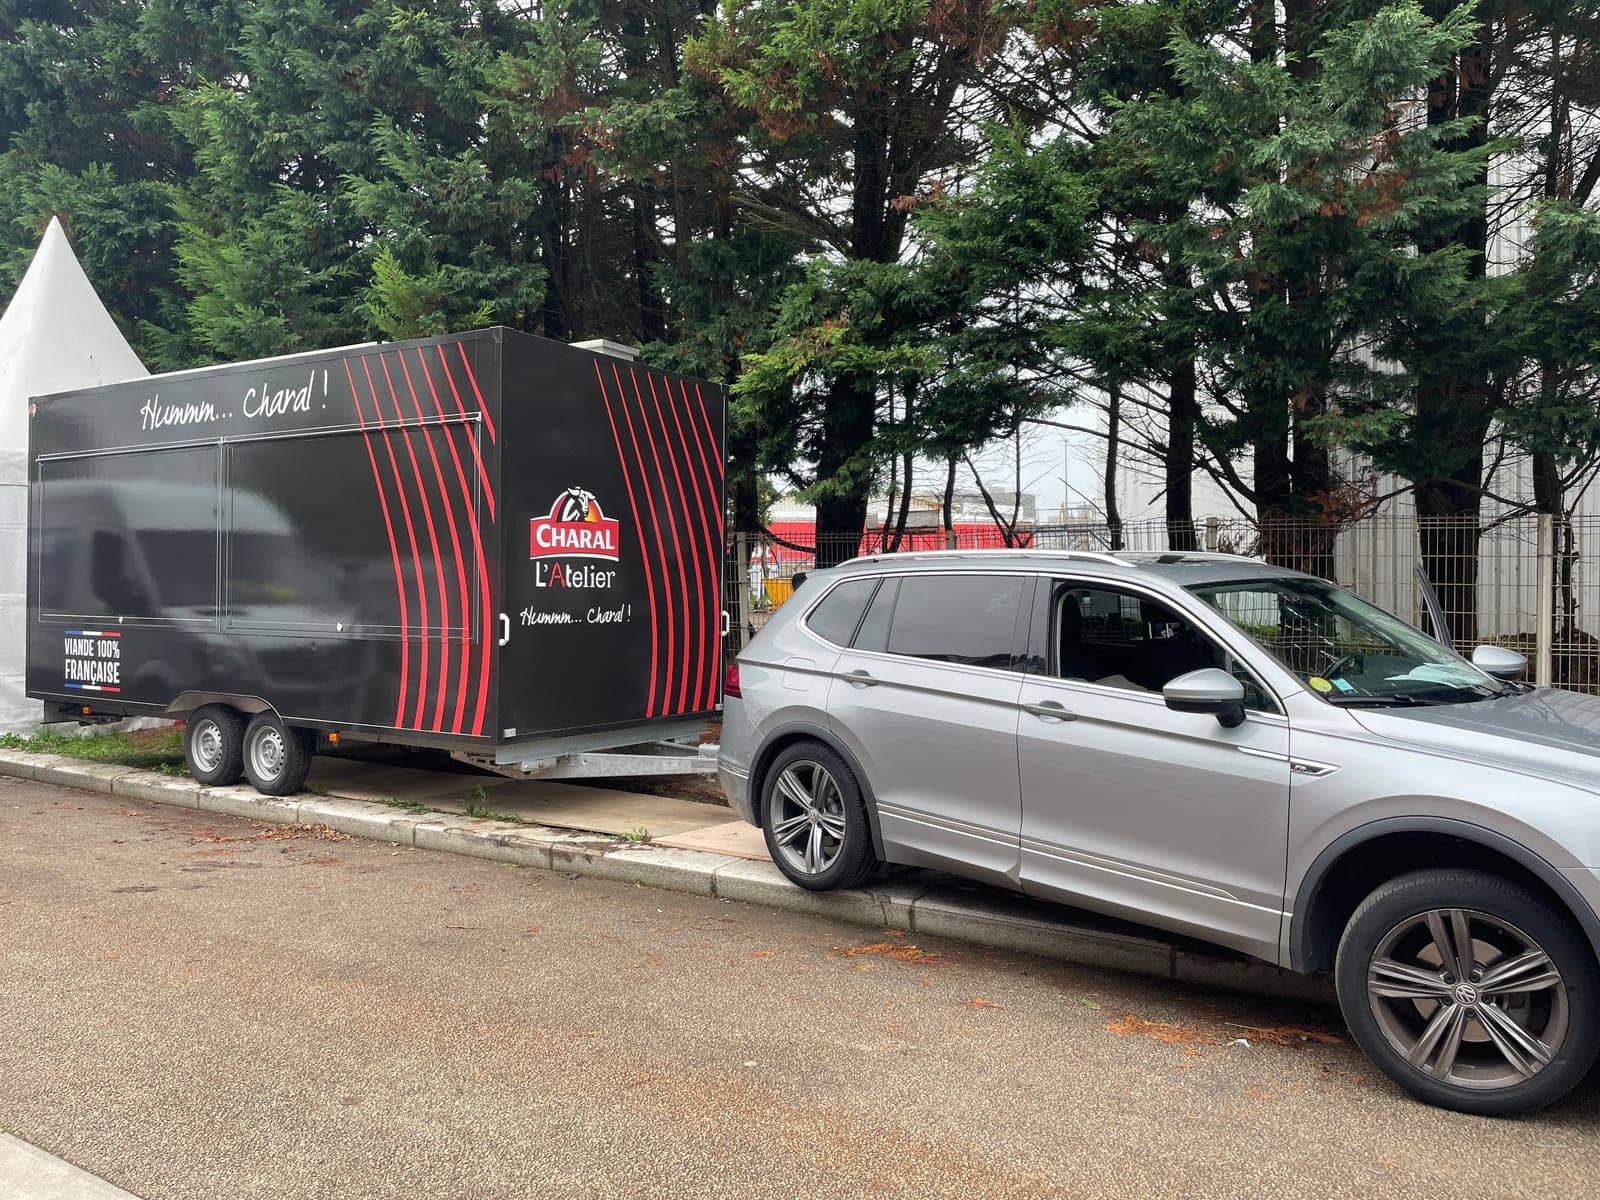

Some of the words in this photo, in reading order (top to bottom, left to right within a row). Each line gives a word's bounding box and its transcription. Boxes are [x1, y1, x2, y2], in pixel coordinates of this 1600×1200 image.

[536, 523, 615, 550] CHARAL
[535, 561, 616, 588] L'Atelier
[64, 638, 94, 656] VIANDE
[97, 640, 120, 659] 100%
[64, 659, 120, 685] FRANÇAISE
